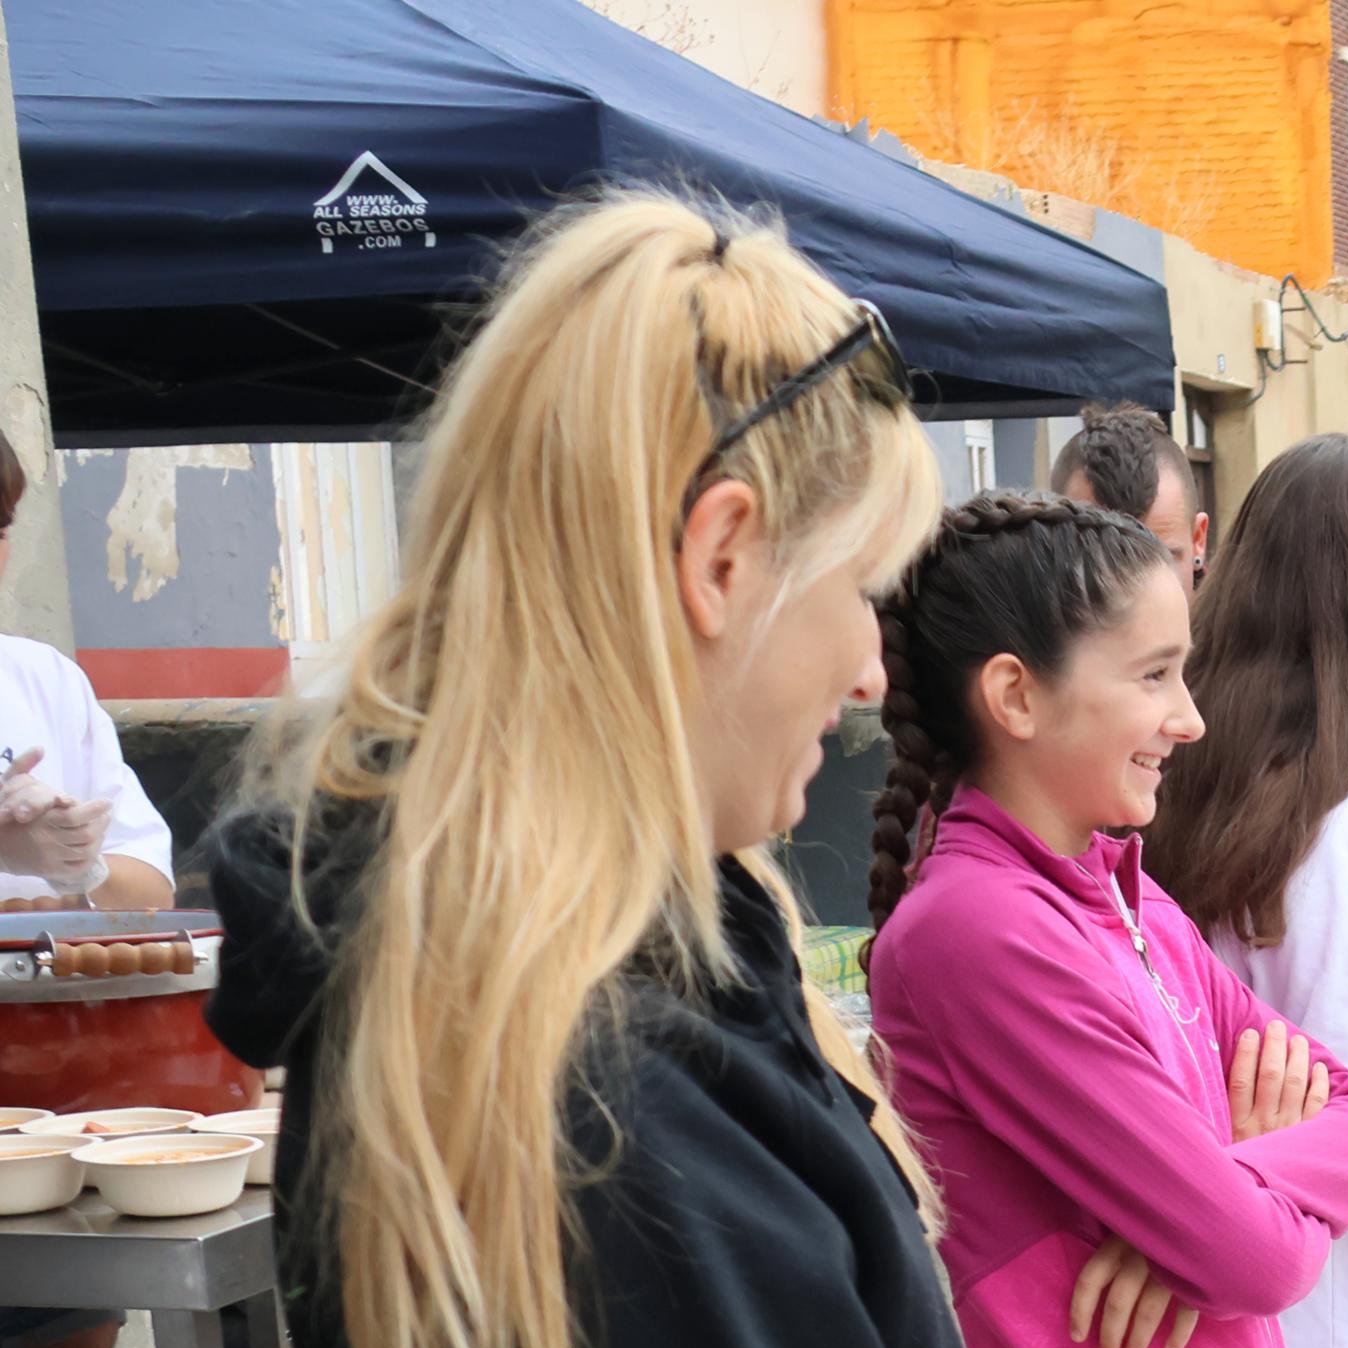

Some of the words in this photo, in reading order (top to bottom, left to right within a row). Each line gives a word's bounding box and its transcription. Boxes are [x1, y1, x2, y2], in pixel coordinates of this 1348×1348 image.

[346, 195, 399, 206] WWW.
[313, 206, 343, 219] ALL
[349, 204, 427, 217] SEASONS
[316, 218, 430, 236] GAZEBOS
[358, 235, 402, 250] .COM
